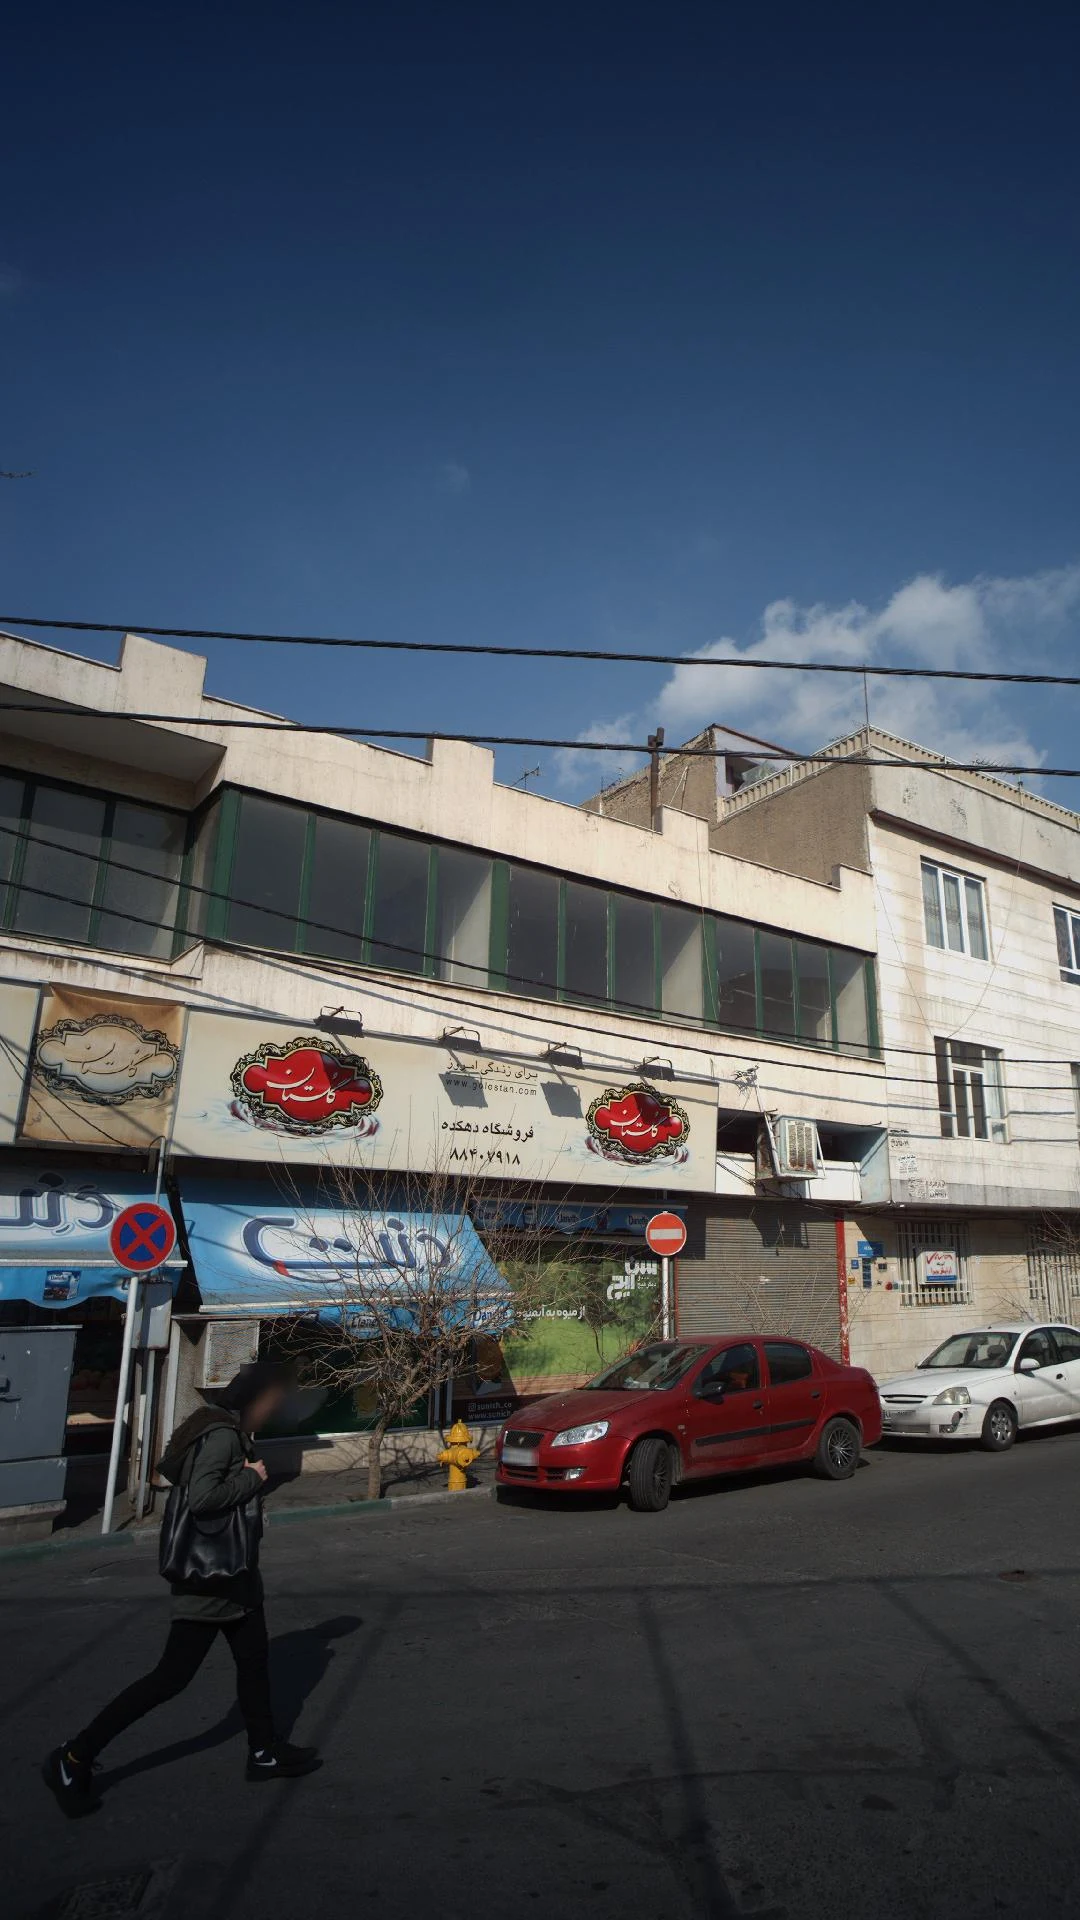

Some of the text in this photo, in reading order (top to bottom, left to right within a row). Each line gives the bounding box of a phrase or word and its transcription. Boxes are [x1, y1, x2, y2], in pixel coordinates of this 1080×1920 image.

[446, 1058, 538, 1081] برای زندگی امروز
[446, 1079, 537, 1096] www.golostan.com
[441, 1120, 534, 1142] فروشگاه دهکده
[449, 1147, 521, 1165] ۸۸۴۰۷۹۱۸
[545, 1308, 556, 1320] به
[556, 1308, 578, 1320] میوه
[577, 1304, 586, 1320] از
